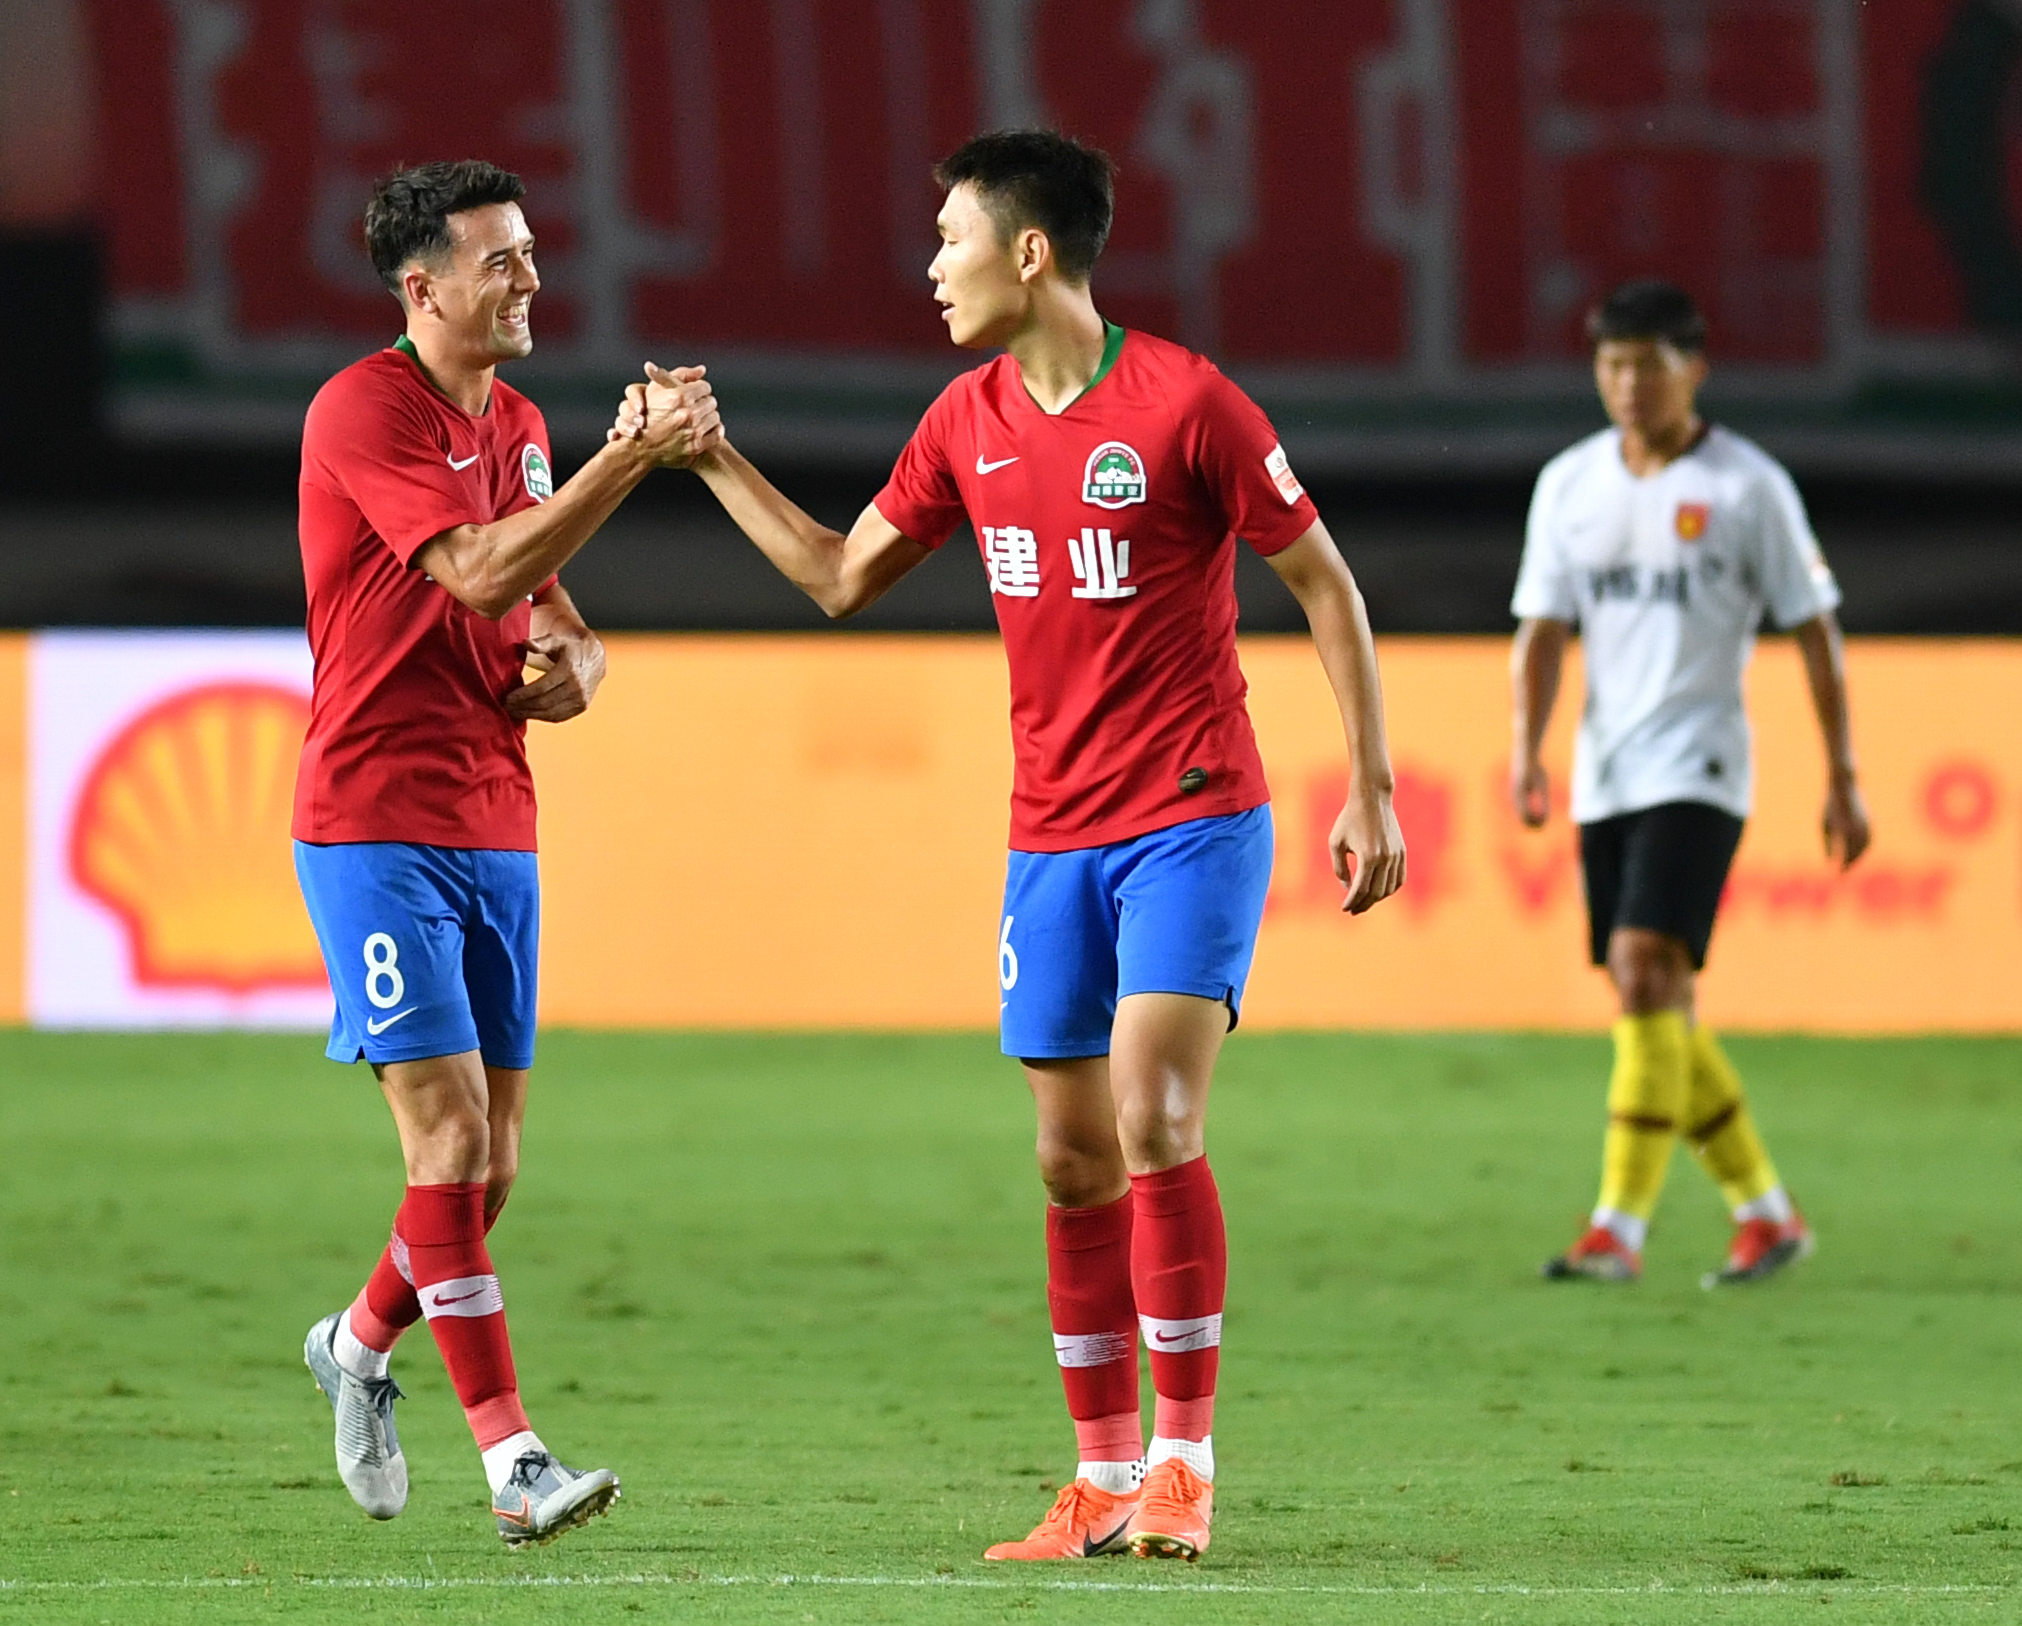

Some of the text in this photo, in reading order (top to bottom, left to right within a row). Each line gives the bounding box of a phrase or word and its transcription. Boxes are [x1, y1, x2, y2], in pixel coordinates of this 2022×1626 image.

[982, 526, 1137, 598] 建业
[363, 932, 404, 1009] 8
[999, 915, 1018, 990] 6
